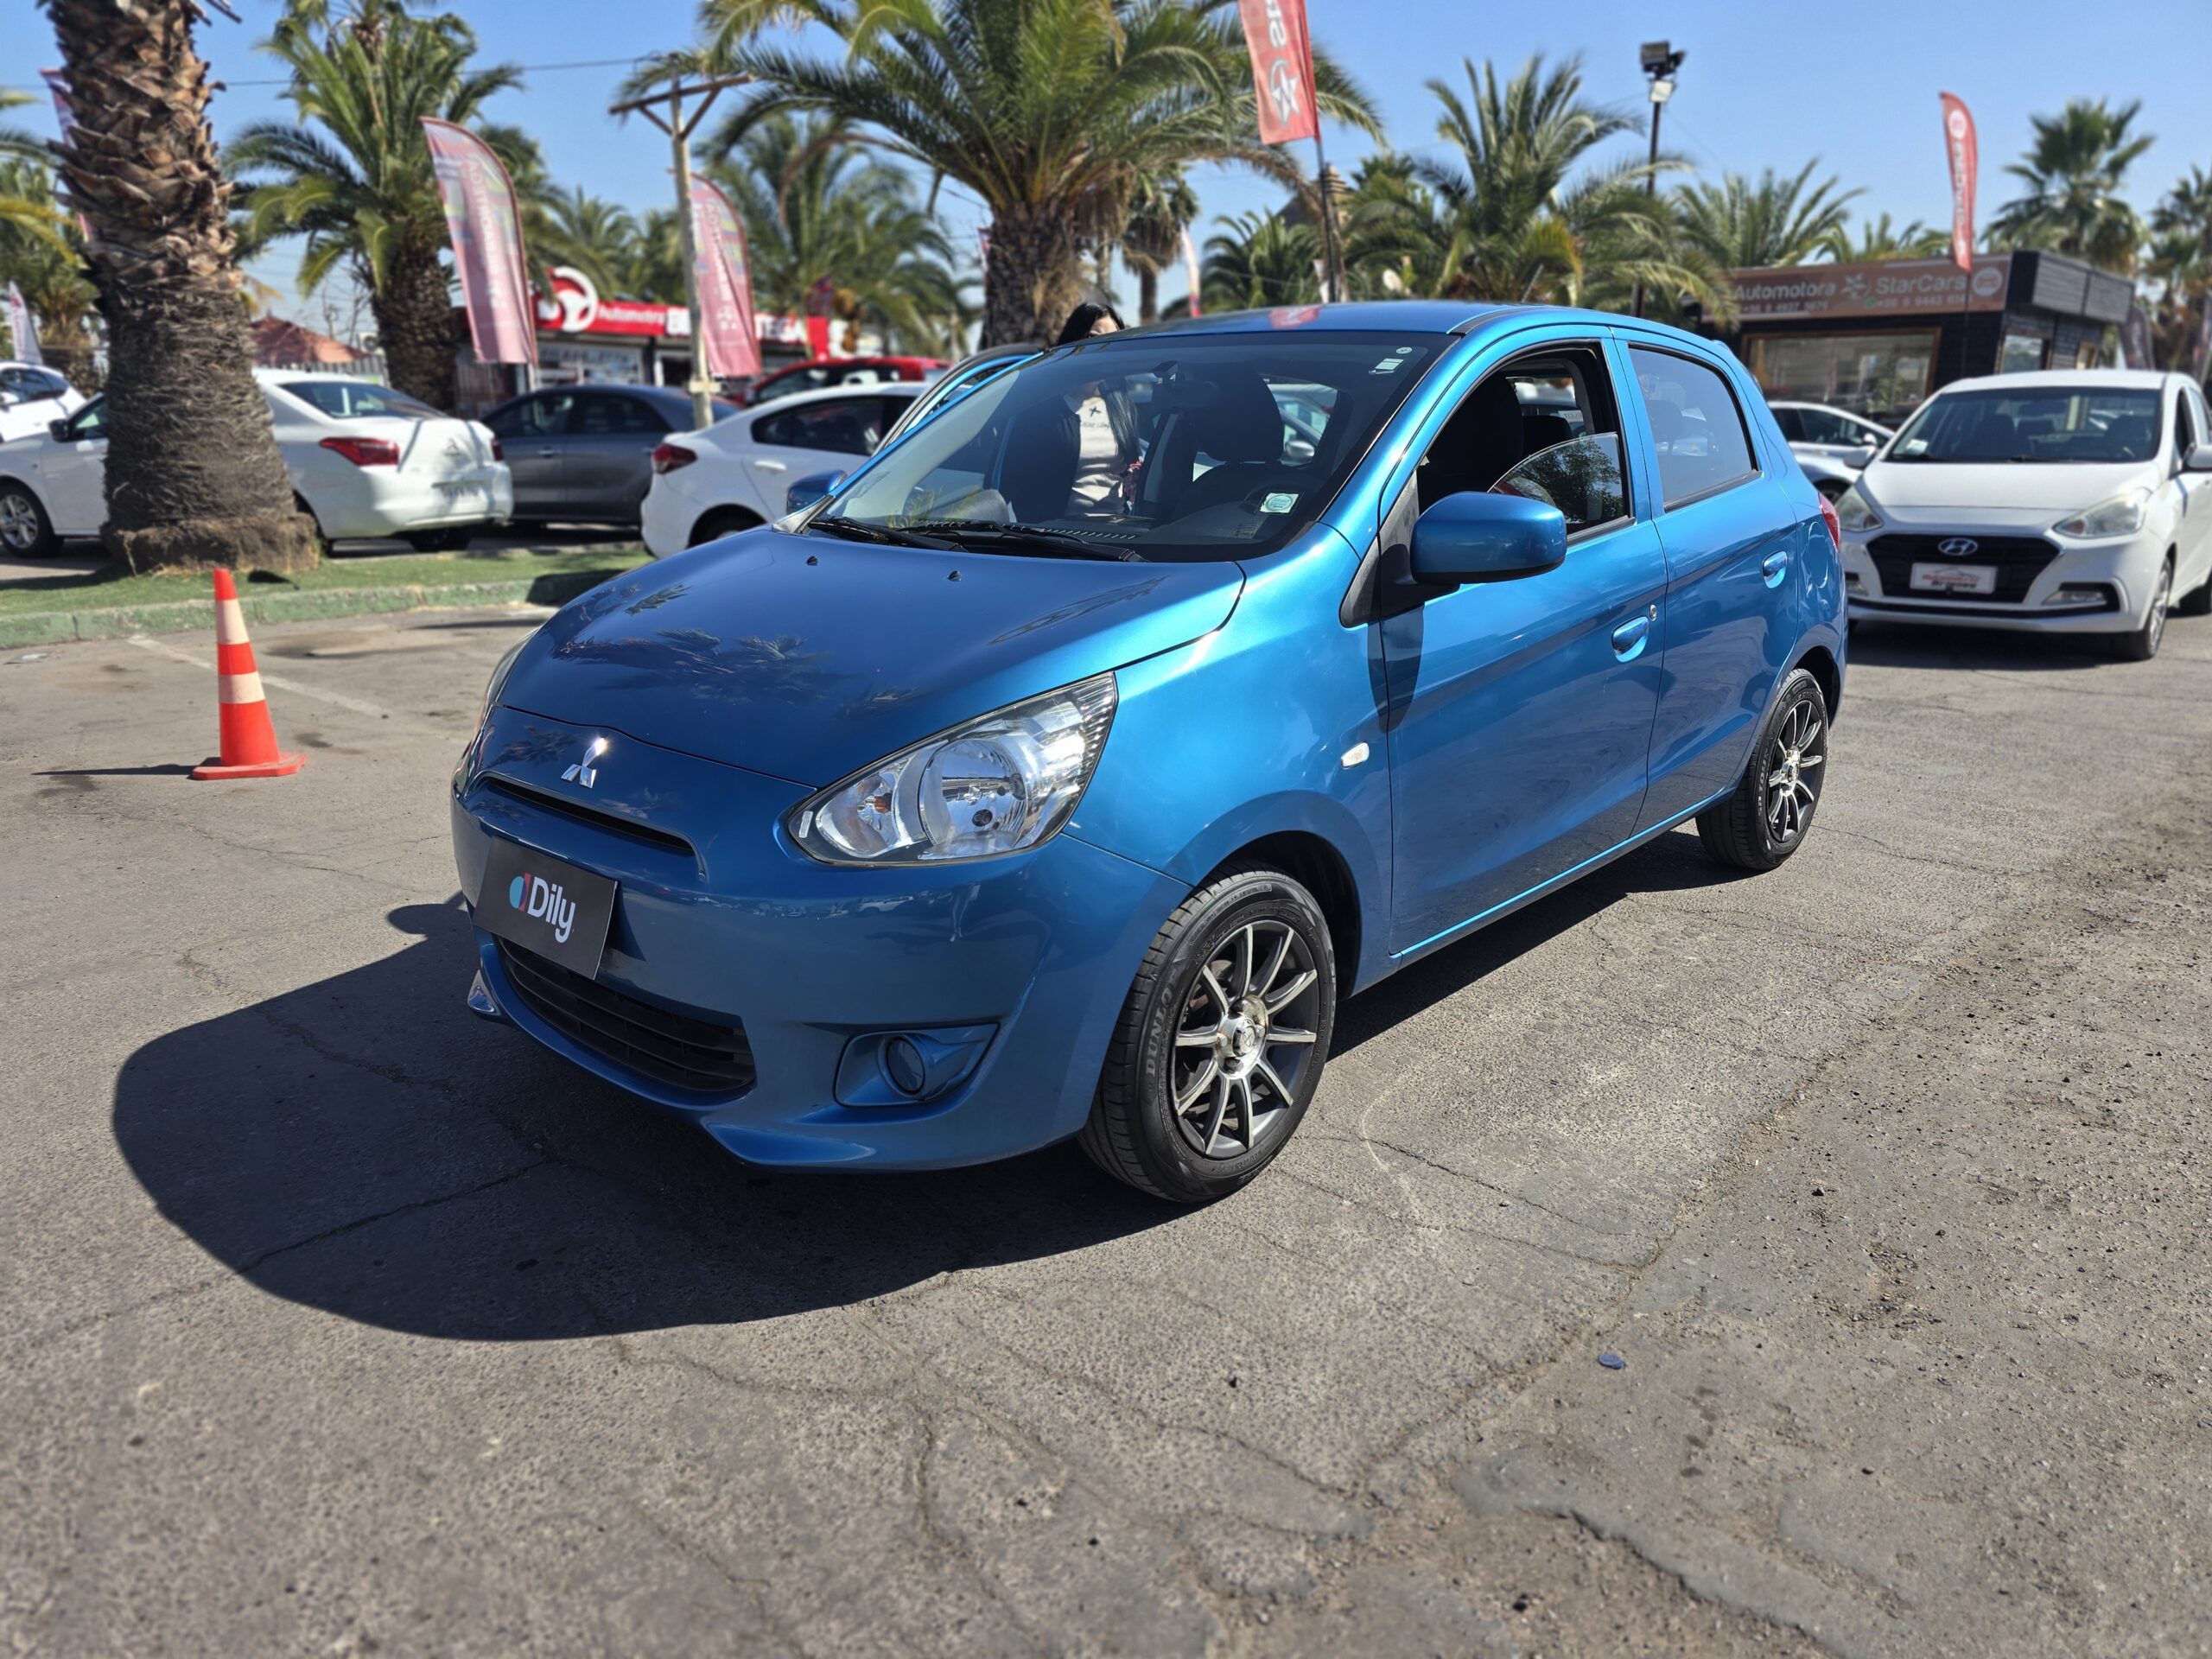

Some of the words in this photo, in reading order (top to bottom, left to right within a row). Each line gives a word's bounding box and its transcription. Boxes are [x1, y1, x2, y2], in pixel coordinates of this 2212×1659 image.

[1735, 282, 1836, 301] Automotora
[1876, 274, 1967, 296] StarCars
[527, 875, 576, 944] Dily
